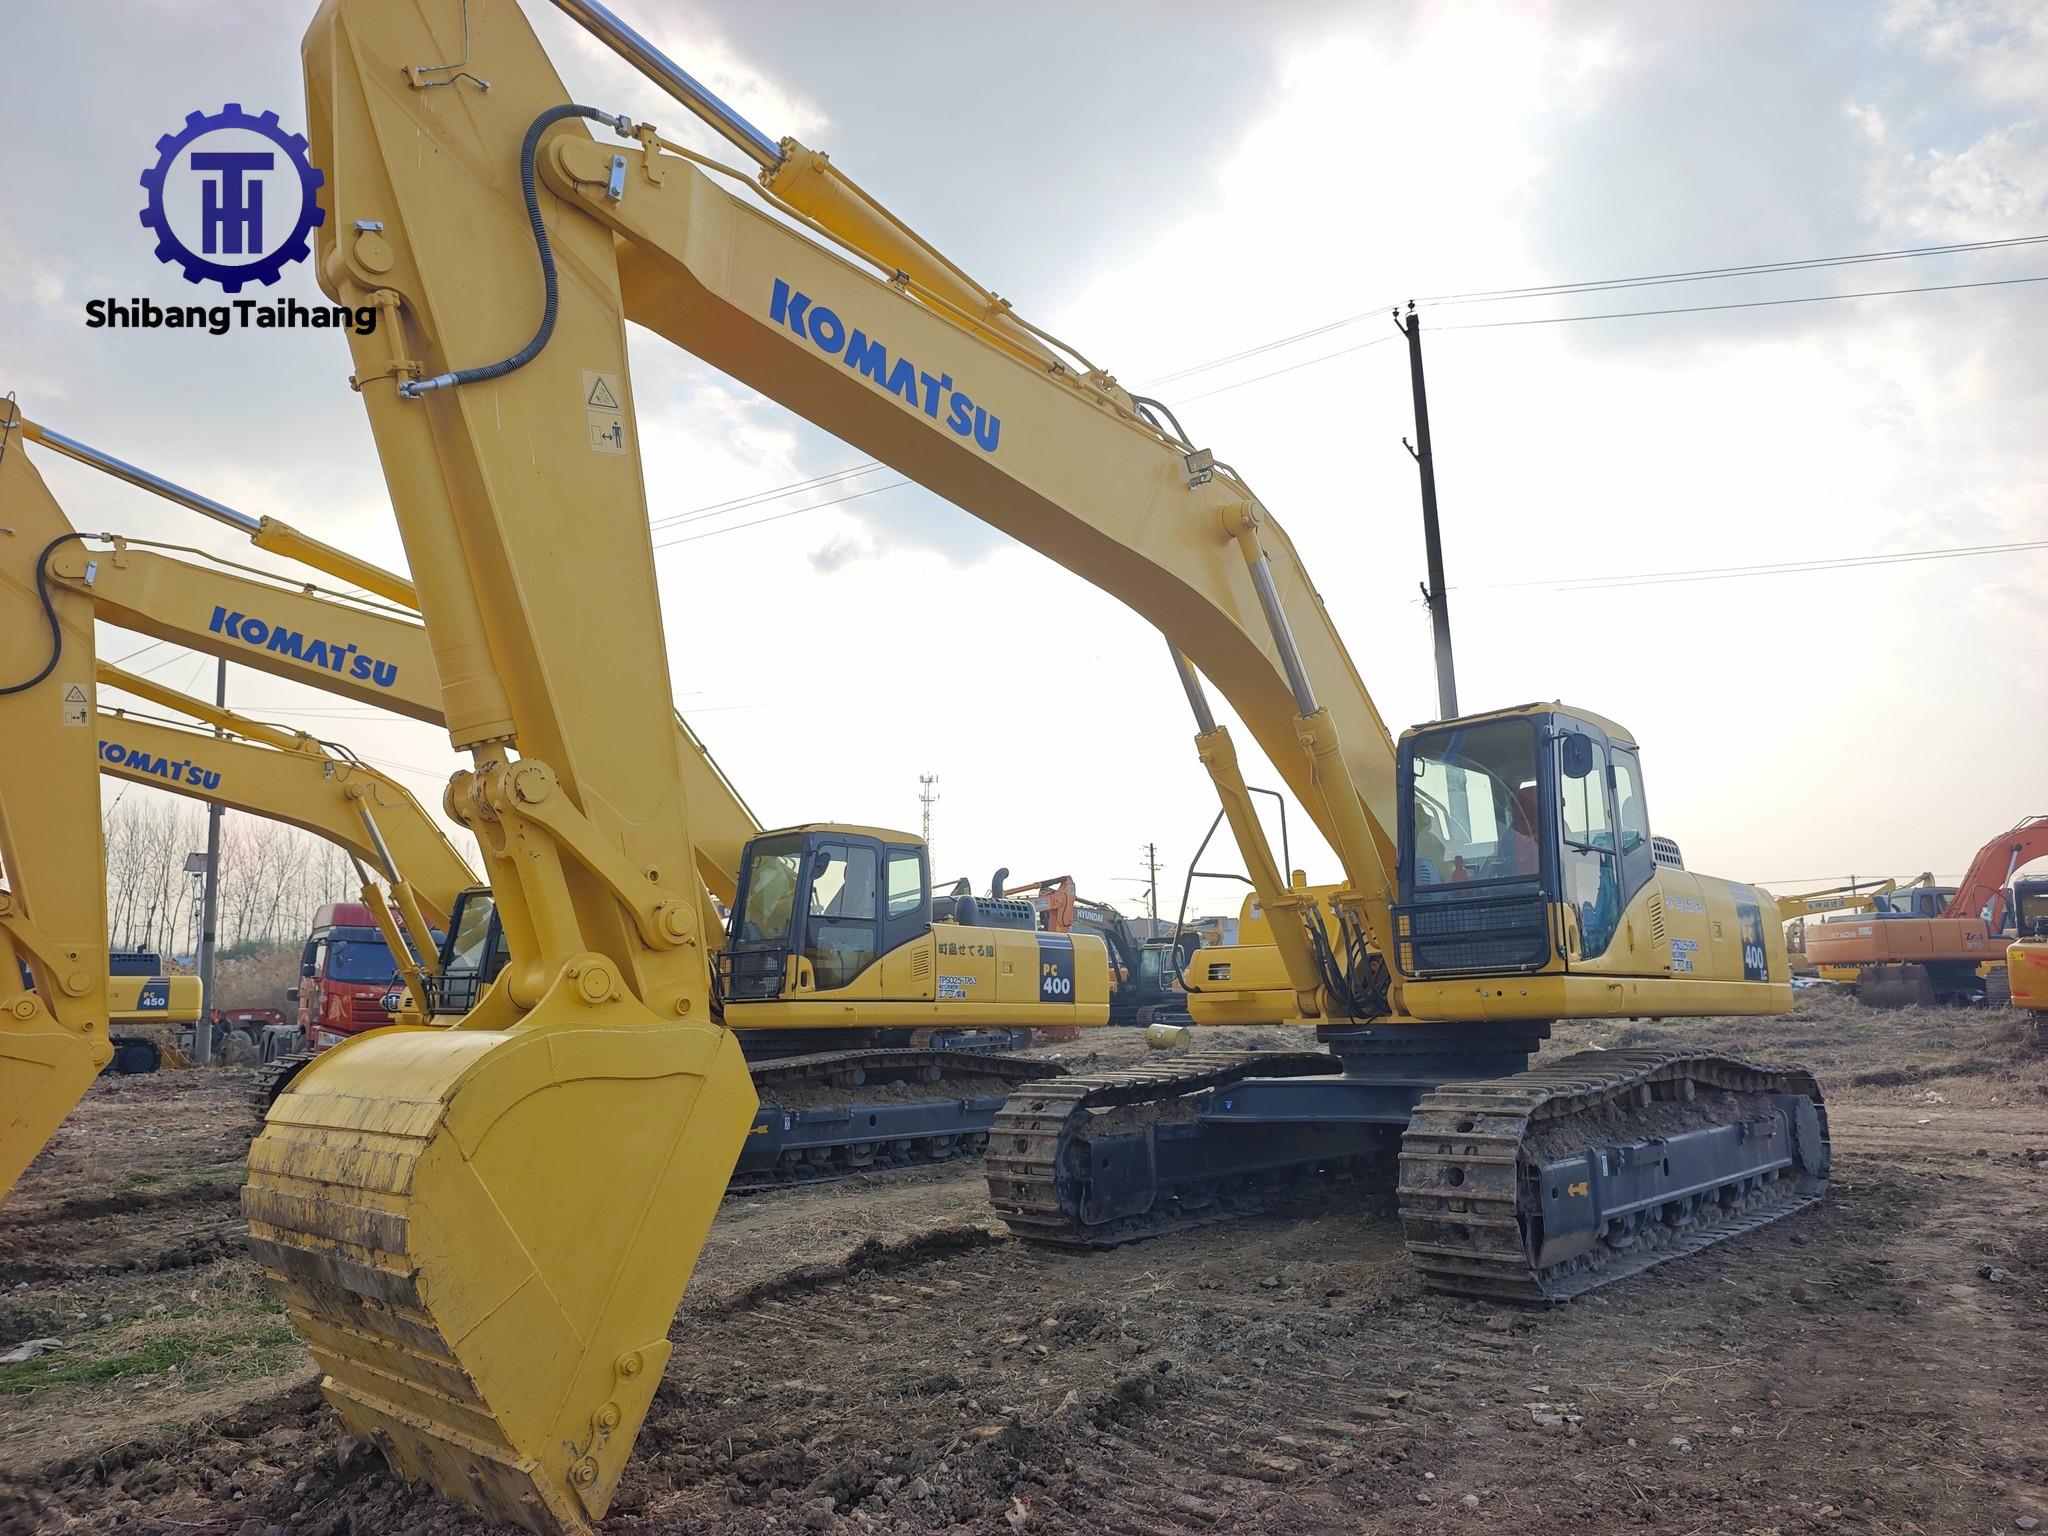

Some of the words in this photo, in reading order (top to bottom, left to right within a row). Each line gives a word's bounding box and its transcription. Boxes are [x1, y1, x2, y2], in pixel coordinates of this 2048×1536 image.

[769, 278, 1001, 452] KOMATSU
[209, 606, 398, 687] KOMATSU
[1077, 910, 1104, 922] HYUNDAI
[1745, 945, 1764, 969] 400
[1043, 964, 1058, 976] PC
[1043, 978, 1070, 994] 400
[143, 998, 165, 1006] 450
